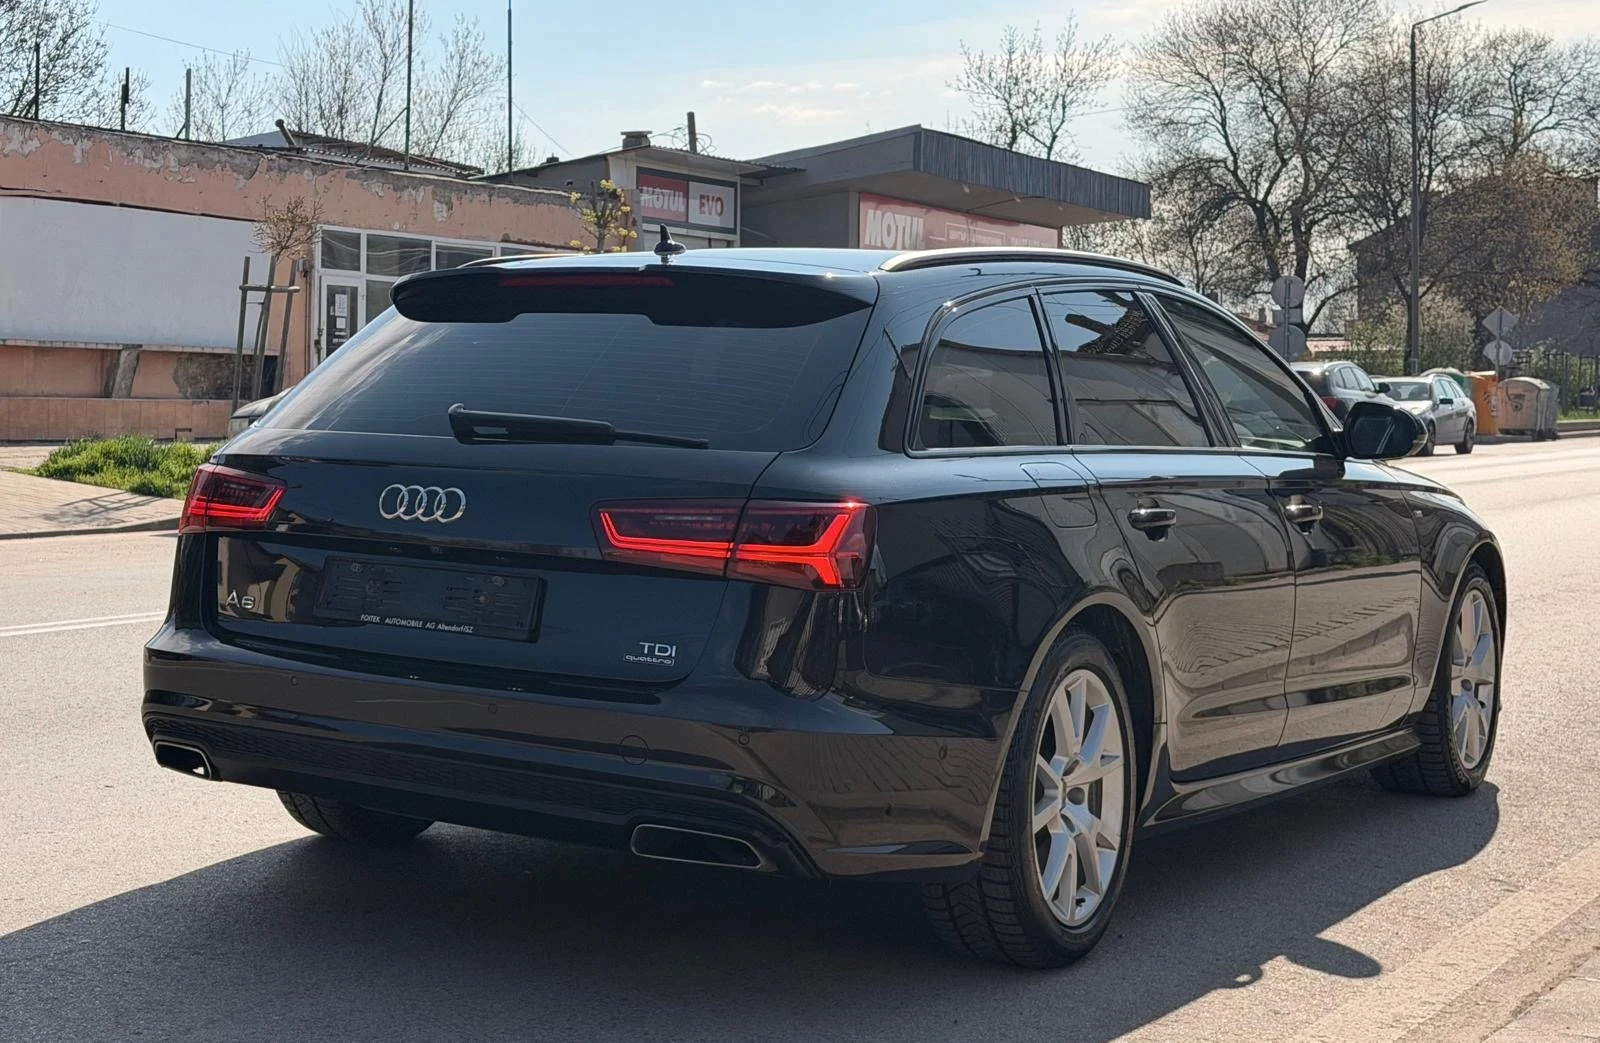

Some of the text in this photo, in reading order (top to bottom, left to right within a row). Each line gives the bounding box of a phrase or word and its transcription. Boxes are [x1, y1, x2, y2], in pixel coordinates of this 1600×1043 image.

[639, 186, 724, 217] MOTUL EVO
[864, 208, 925, 250] MOTUL
[225, 589, 254, 609] A6
[360, 614, 380, 623] FOITEK
[384, 617, 423, 628] AUTOMOBILE
[425, 622, 436, 630] AG
[639, 641, 677, 658] TDI
[625, 654, 672, 664] quattro
